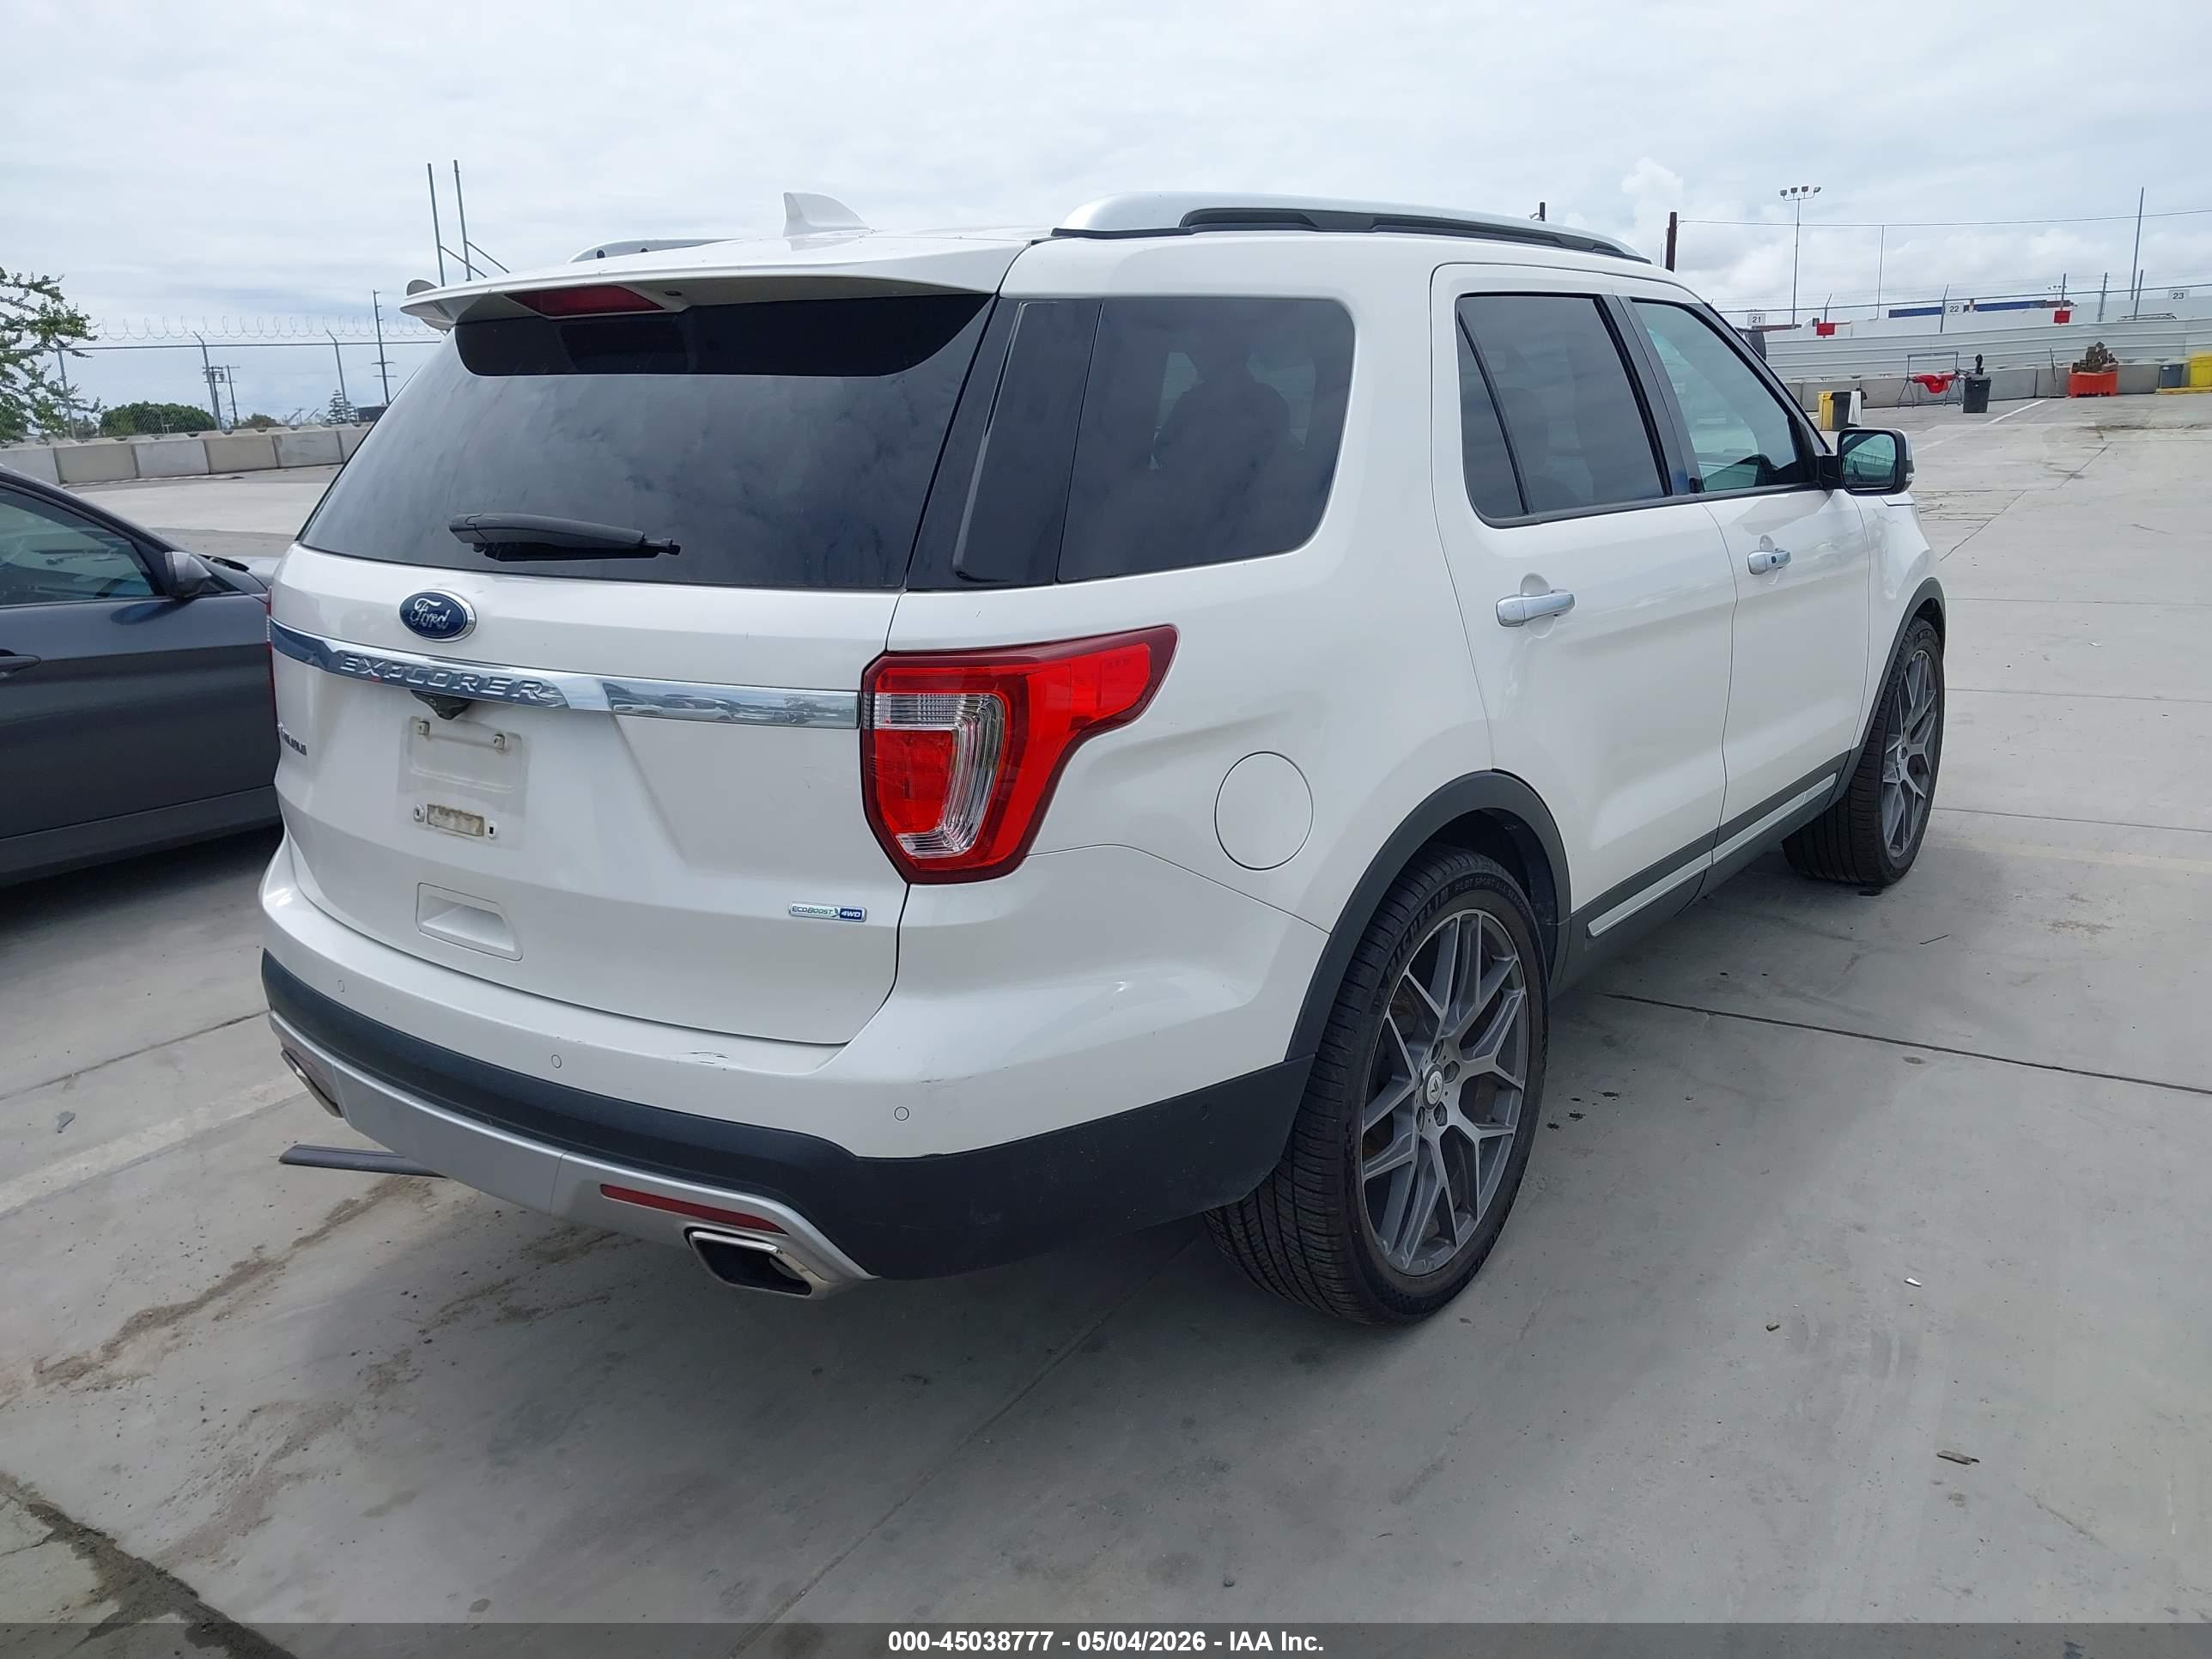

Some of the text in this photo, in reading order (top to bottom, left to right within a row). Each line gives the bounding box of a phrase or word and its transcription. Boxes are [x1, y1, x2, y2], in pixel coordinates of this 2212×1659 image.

[1752, 315, 1761, 324] 21
[410, 598, 452, 629] Ford
[339, 654, 544, 701] EXPLORER
